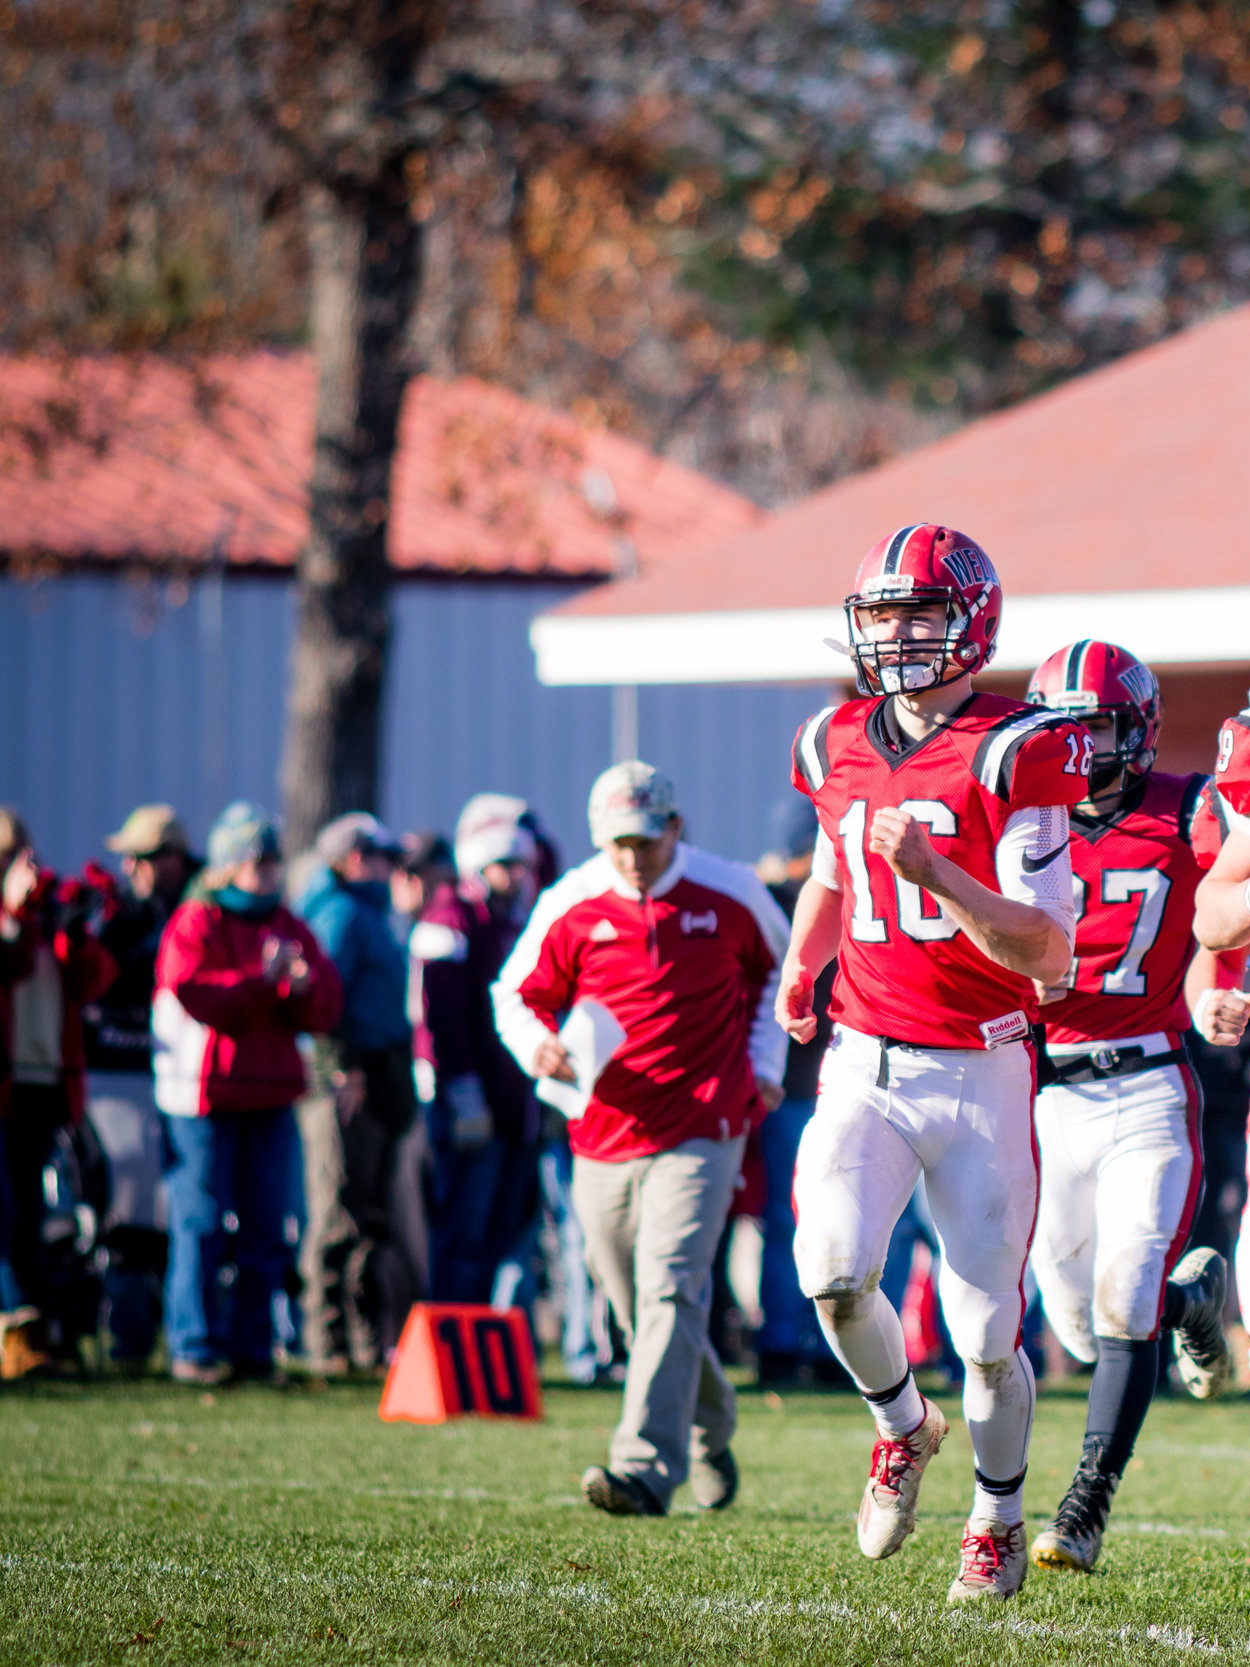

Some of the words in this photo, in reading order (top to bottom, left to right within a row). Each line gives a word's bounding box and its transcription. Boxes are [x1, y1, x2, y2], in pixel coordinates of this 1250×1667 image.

[838, 798, 962, 943] 16
[1070, 868, 1173, 997] 7
[987, 1015, 1022, 1036] Riddell
[437, 1316, 525, 1413] 10
